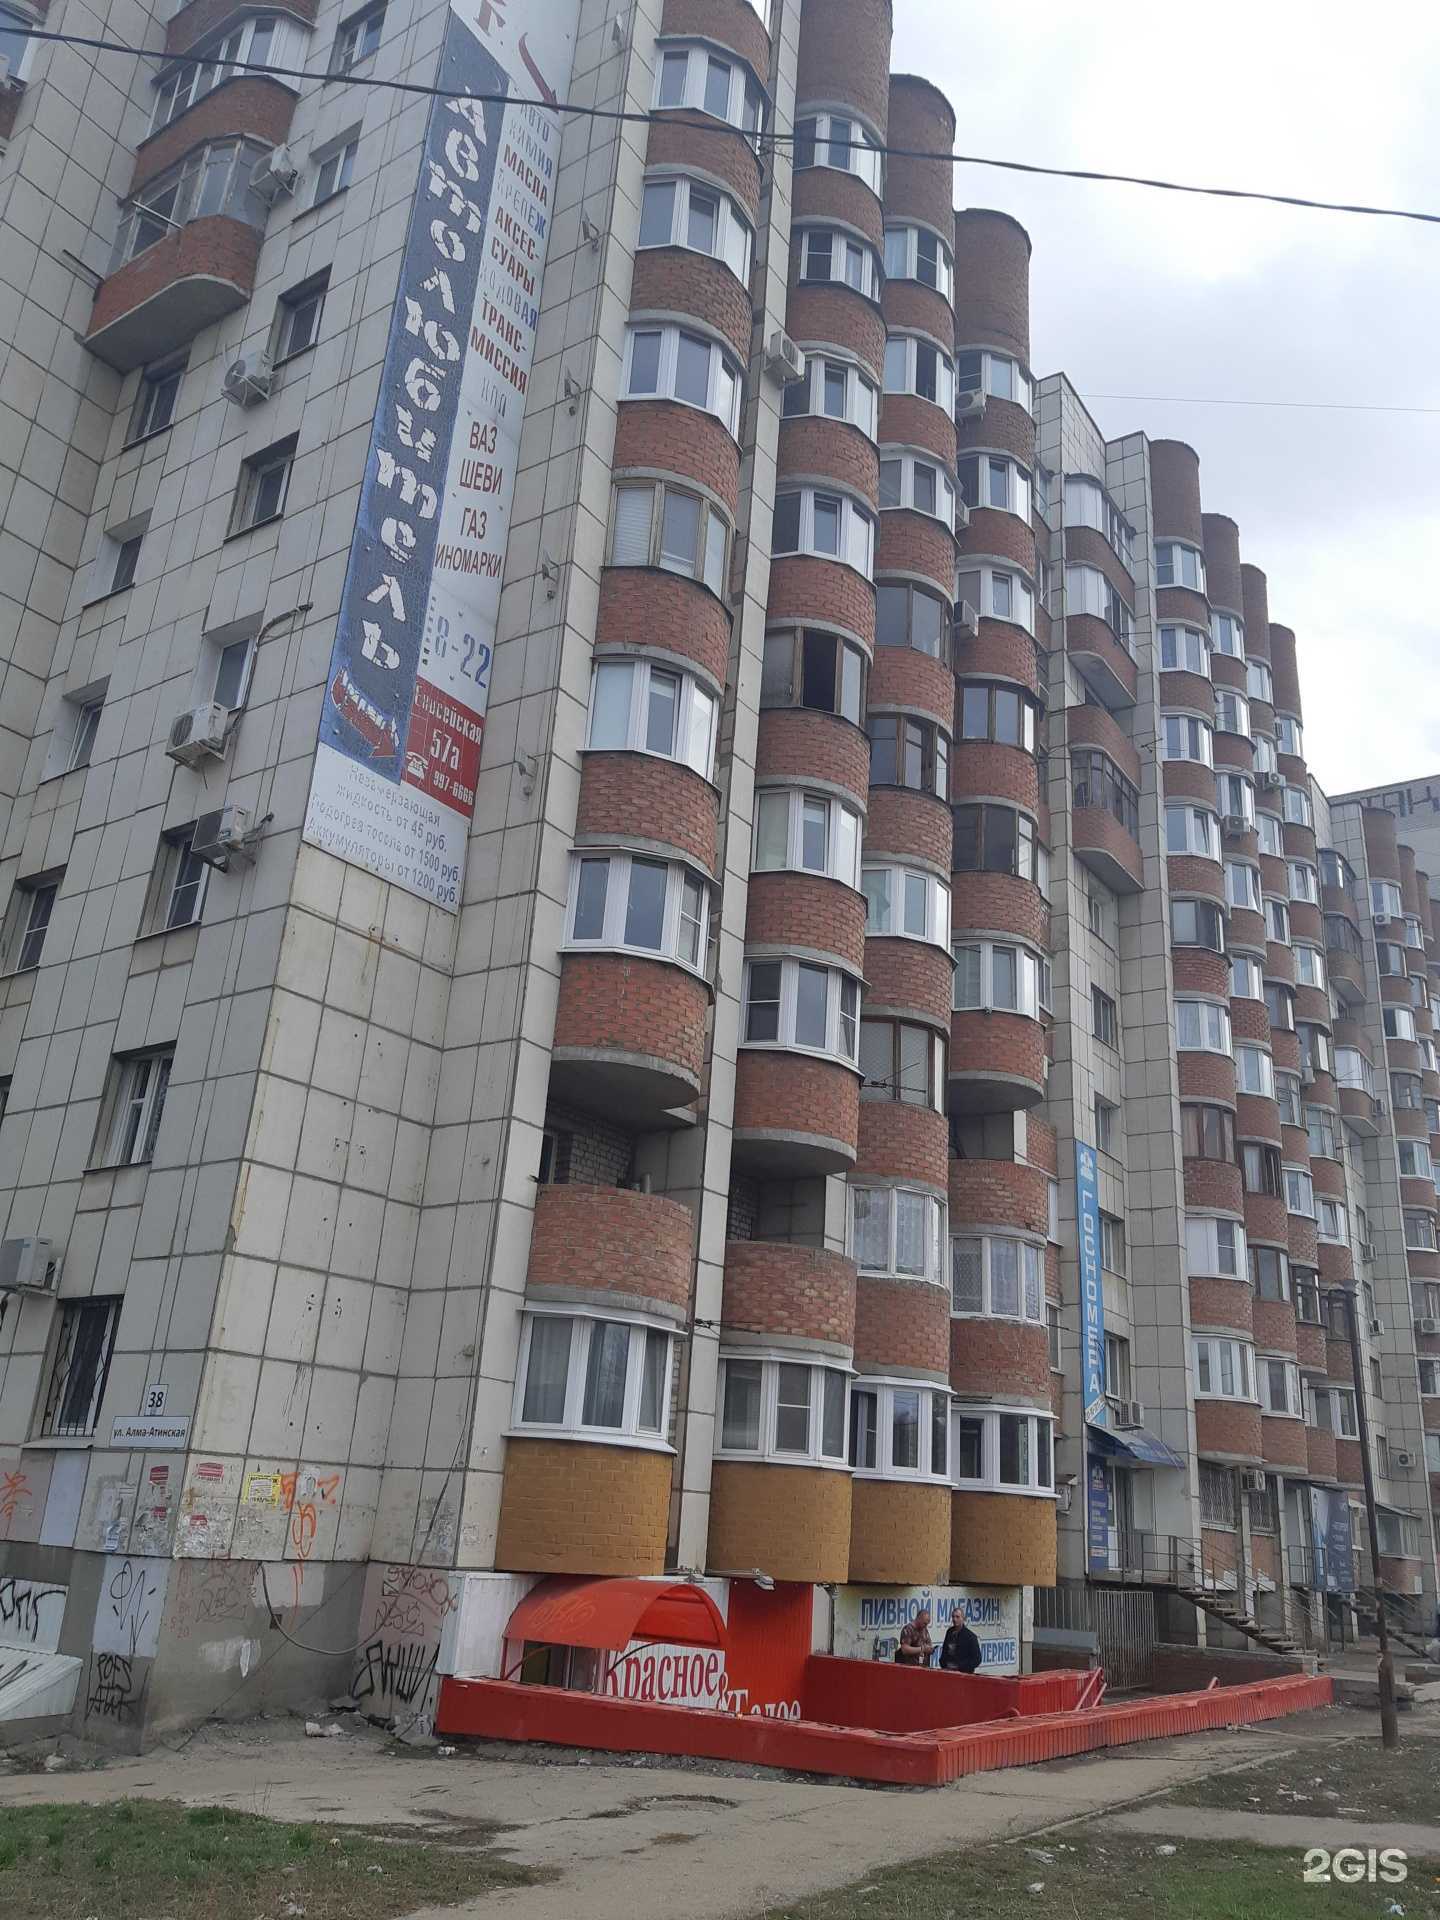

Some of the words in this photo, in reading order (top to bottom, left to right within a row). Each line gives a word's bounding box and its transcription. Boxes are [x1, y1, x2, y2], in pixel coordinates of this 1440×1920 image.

[503, 143, 548, 208] МАСЛА
[495, 205, 540, 261] АКСЕС-
[491, 236, 536, 297] СУАРЫ
[482, 296, 526, 353] ТРАНС-
[470, 325, 527, 395] МИССИЯ
[469, 421, 498, 454] ВАЗ
[459, 458, 503, 496] ШЕВИ
[460, 507, 488, 540] ГАЗ
[434, 543, 503, 579] ИНОМАРКИ
[414, 683, 482, 745] Енисейская
[430, 728, 460, 771] 57а
[350, 765, 441, 827] Незамерзающая
[433, 770, 474, 806] 997-6666
[397, 815, 409, 830] от
[411, 823, 425, 839] 45
[426, 831, 447, 853] руб.
[397, 864, 410, 879] от
[413, 868, 435, 892] 1200
[436, 883, 459, 905] руб.
[404, 844, 416, 859] от
[419, 849, 440, 873] 1500
[441, 863, 461, 884] руб.
[1081, 1192, 1100, 1394] ГОСНОМЕРА
[148, 1391, 164, 1408] 38
[113, 1428, 124, 1439] ул.
[125, 1426, 186, 1438] Алма-Атинская
[861, 1590, 931, 1626] ПИВНОЙ
[605, 1649, 719, 1700] Красное
